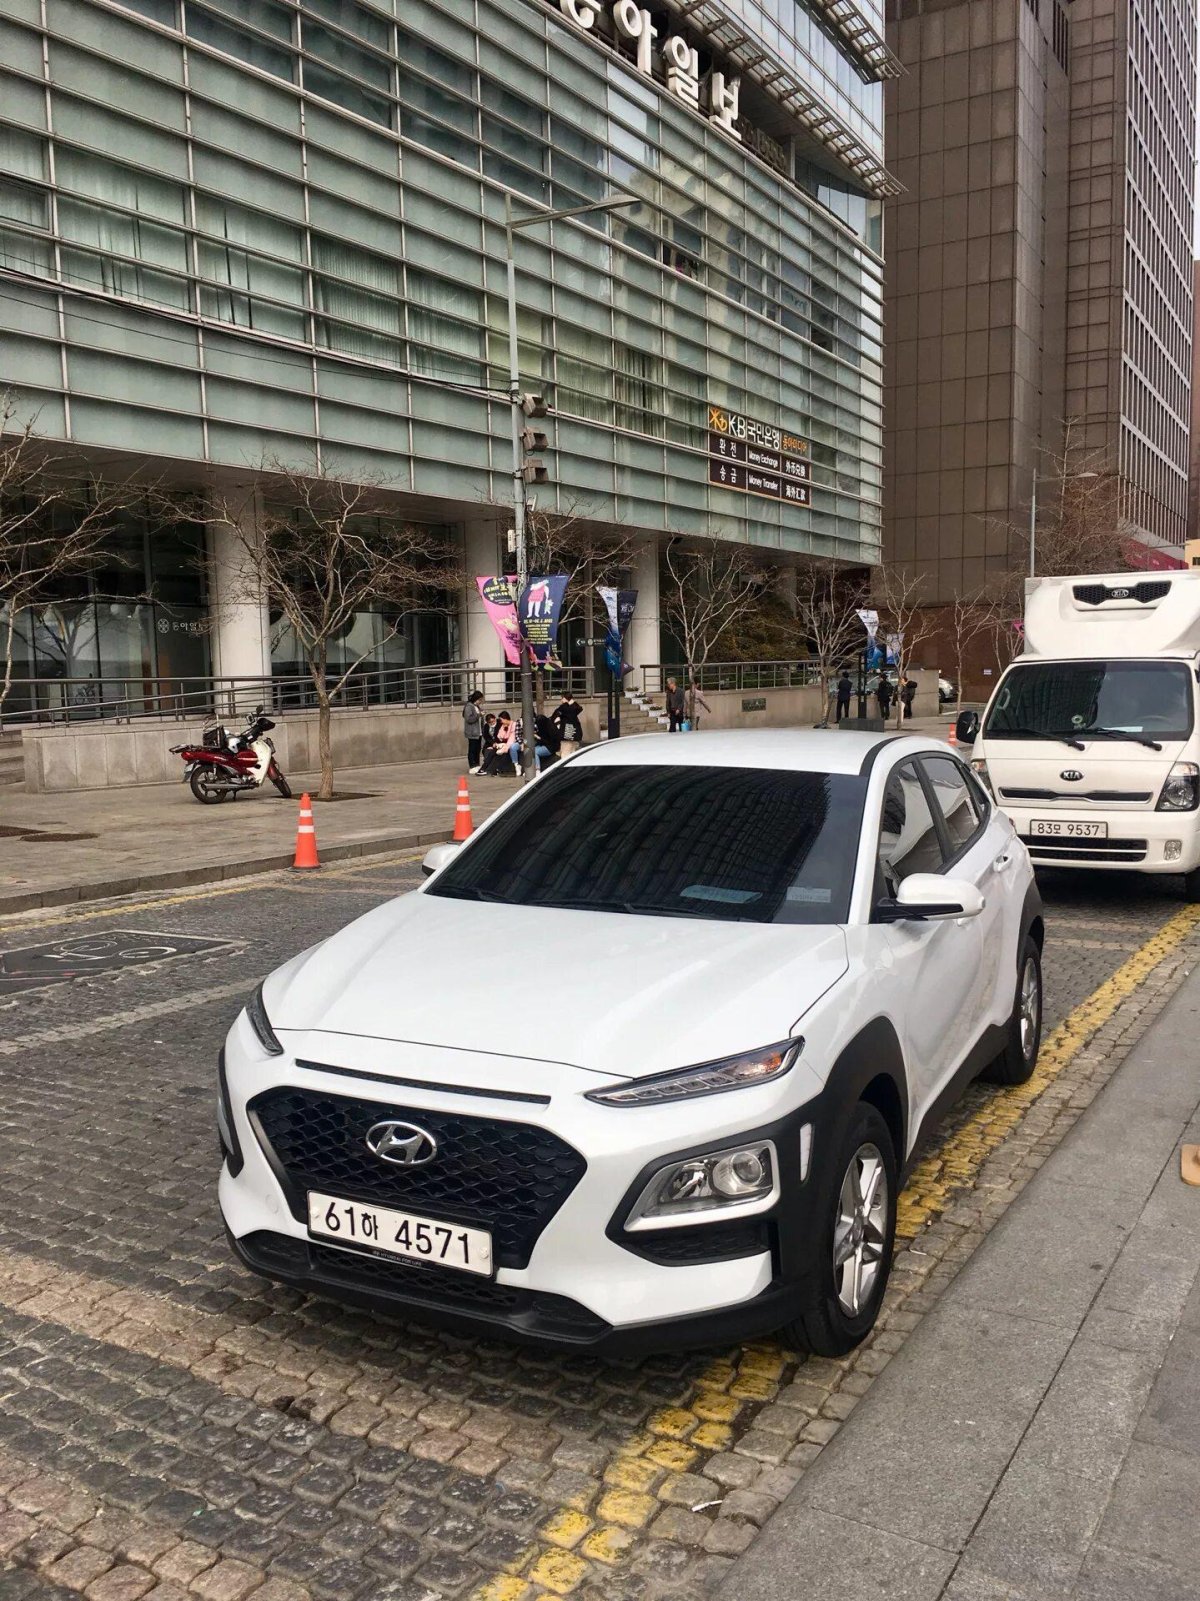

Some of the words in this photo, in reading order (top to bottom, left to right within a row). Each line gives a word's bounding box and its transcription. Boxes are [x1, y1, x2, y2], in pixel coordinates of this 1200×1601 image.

[749, 450, 761, 463] Money
[749, 475, 762, 488] Money
[1063, 771, 1080, 779] KIA
[1067, 823, 1100, 837] 9537
[325, 1202, 379, 1241] 61하
[394, 1219, 470, 1264] 4571
